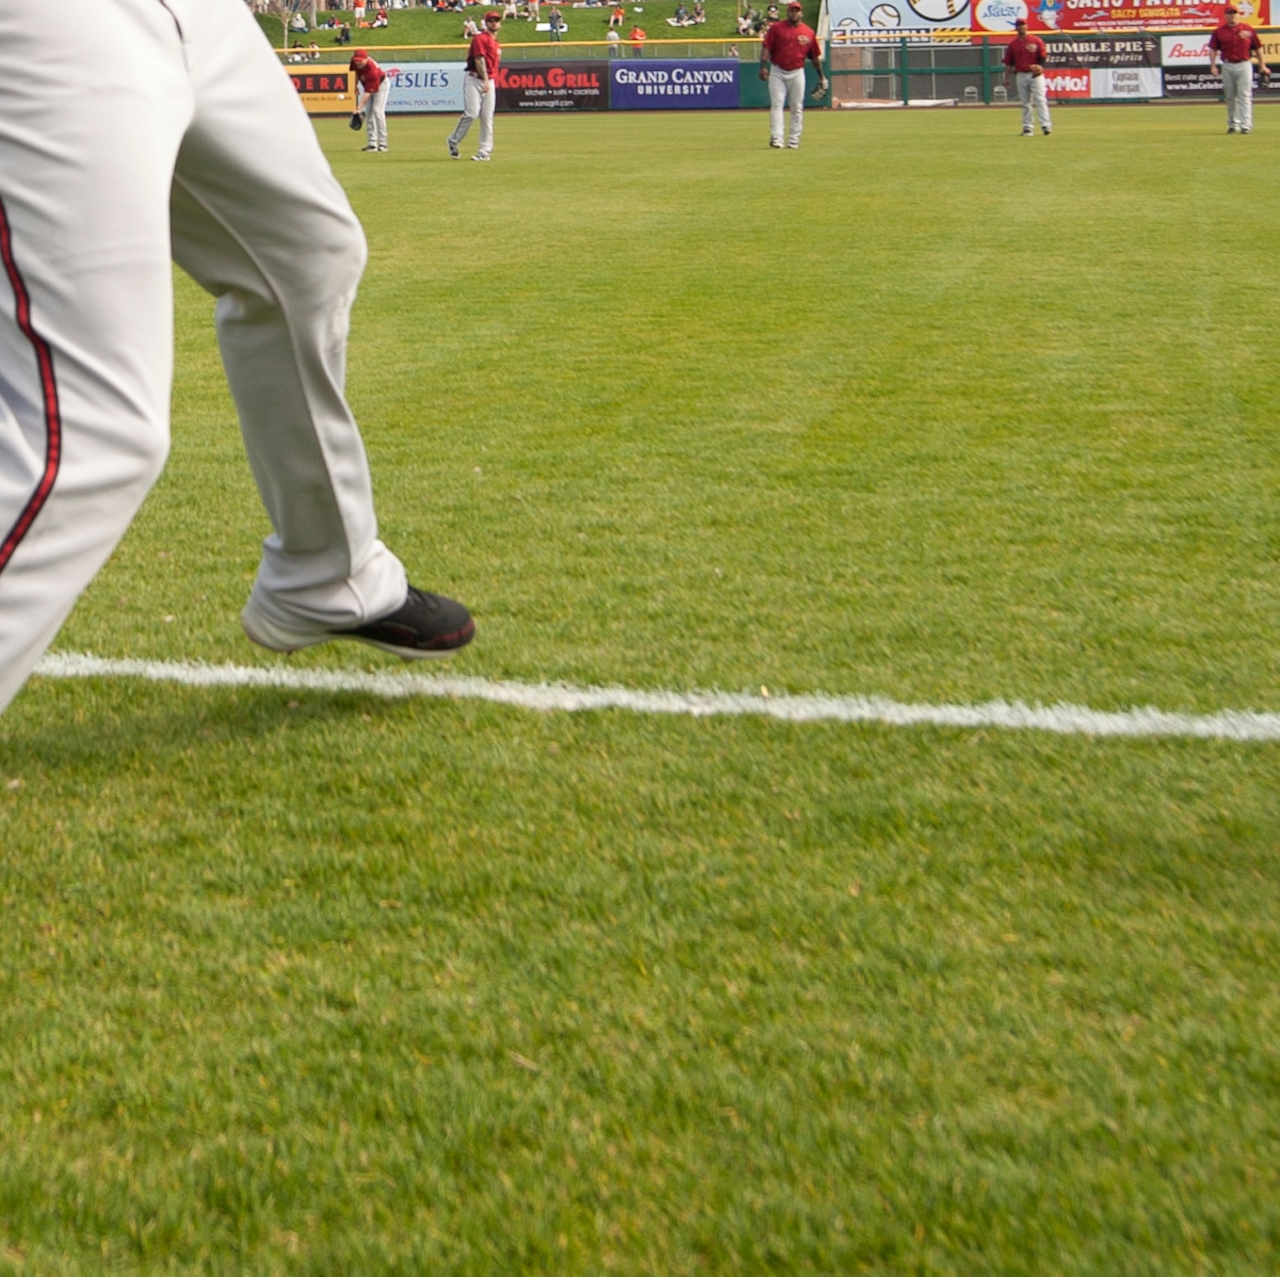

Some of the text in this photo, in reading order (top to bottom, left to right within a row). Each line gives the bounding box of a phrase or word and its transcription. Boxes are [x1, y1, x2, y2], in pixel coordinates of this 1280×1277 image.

[1114, 40, 1144, 52] PIE
[1045, 52, 1143, 64] izza wine spirits
[546, 66, 600, 89] GRILL
[636, 84, 711, 96] UNIVERSITY
